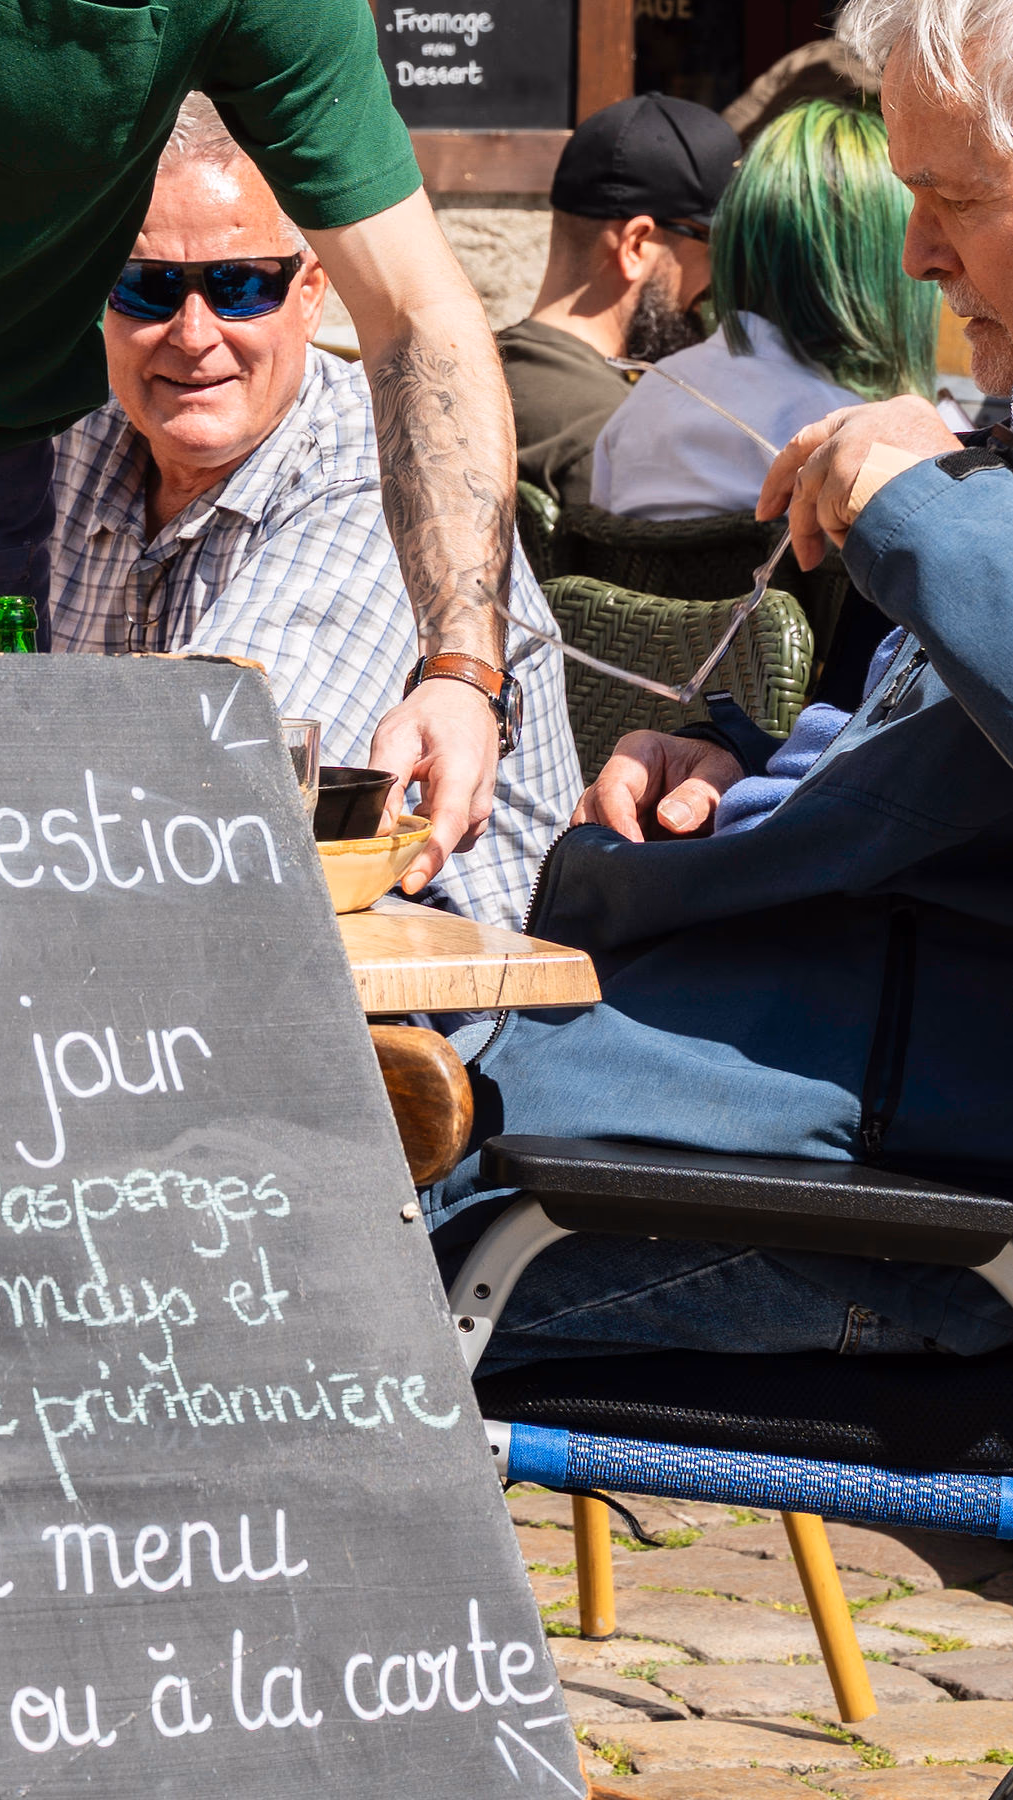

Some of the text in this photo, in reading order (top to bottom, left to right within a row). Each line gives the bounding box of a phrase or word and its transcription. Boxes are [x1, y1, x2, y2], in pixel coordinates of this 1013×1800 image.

[394, 8, 495, 47] Fromage
[396, 60, 483, 87] Dessert
[16, 994, 213, 1169] jour
[224, 1246, 292, 1326] et
[41, 1509, 309, 1594] menu
[9, 1601, 555, 1754] ou à la carte
